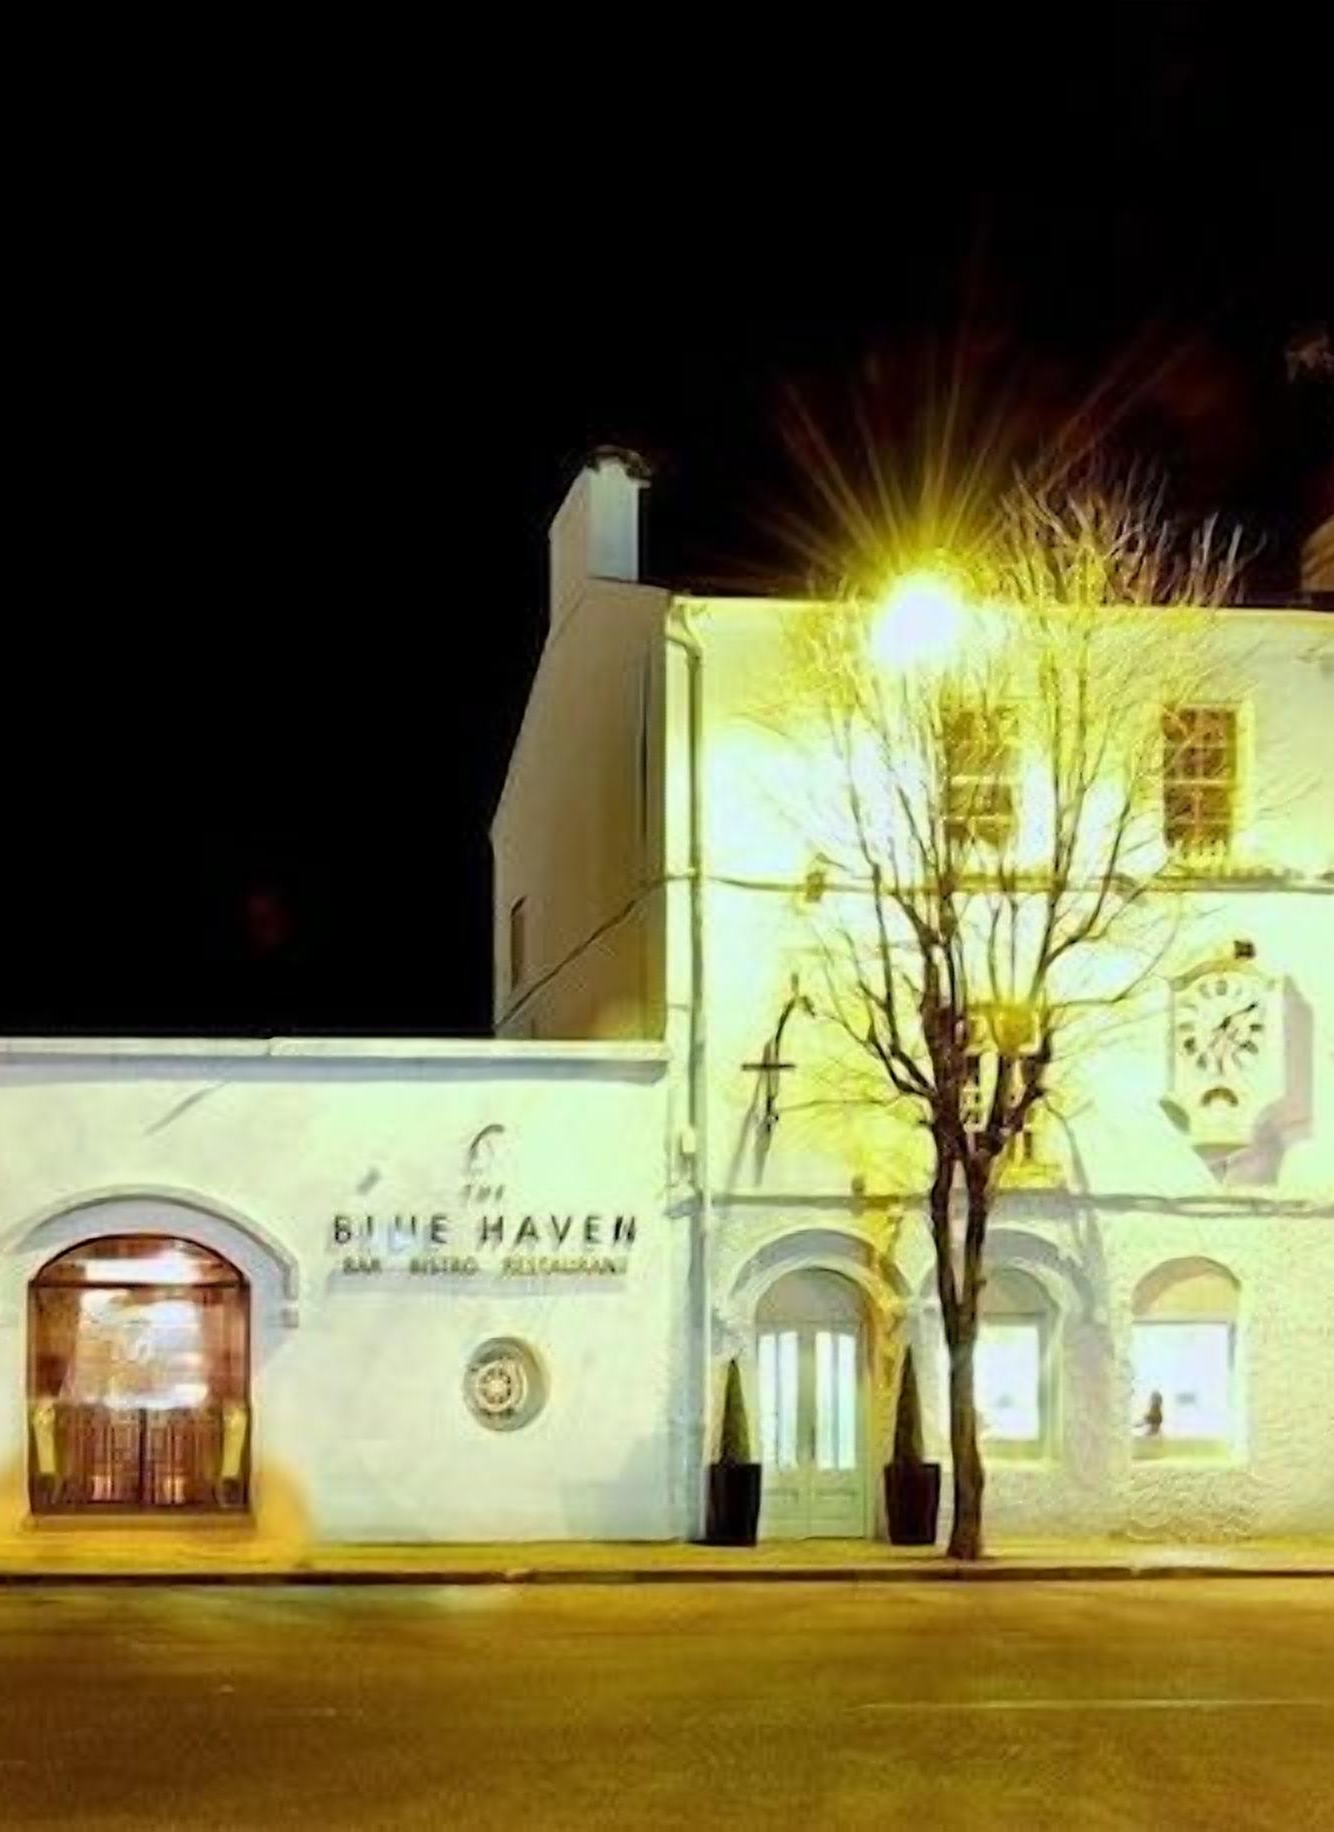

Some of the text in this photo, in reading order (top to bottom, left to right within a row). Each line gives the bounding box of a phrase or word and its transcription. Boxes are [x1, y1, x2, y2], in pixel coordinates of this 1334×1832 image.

[333, 1214, 635, 1246] BLUE HAVEN
[342, 1256, 382, 1275] BAR
